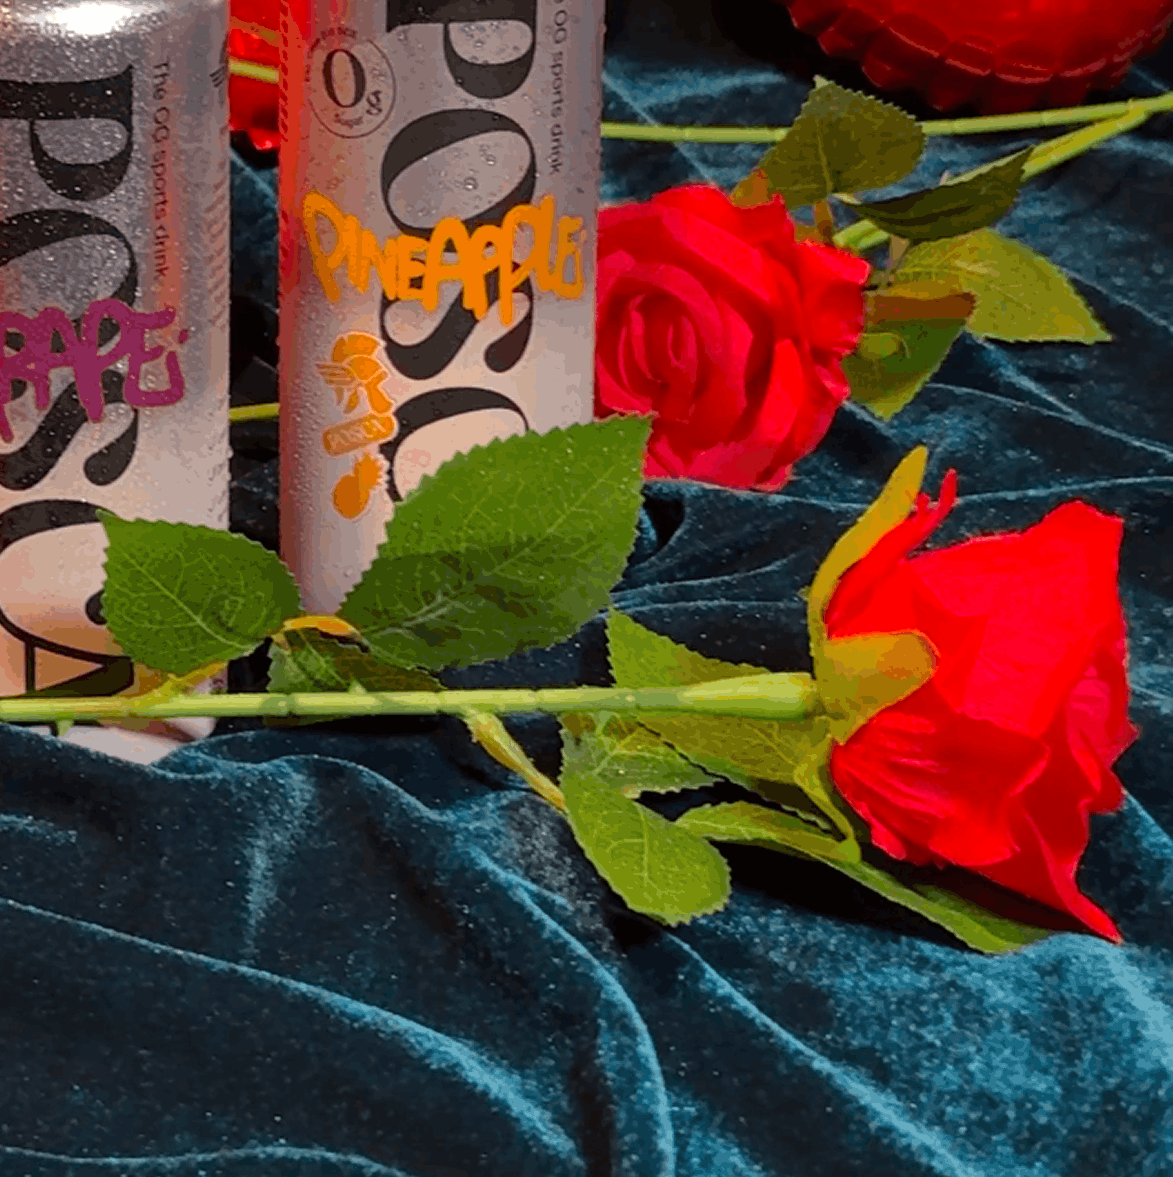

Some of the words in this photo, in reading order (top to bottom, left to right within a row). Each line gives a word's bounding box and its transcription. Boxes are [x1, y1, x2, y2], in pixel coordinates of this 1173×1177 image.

[153, 58, 170, 101] The
[550, 51, 566, 118] sports
[550, 123, 566, 175] drink
[151, 150, 169, 220] sports
[153, 225, 170, 280] drink
[303, 191, 585, 327] PINEAPPLE
